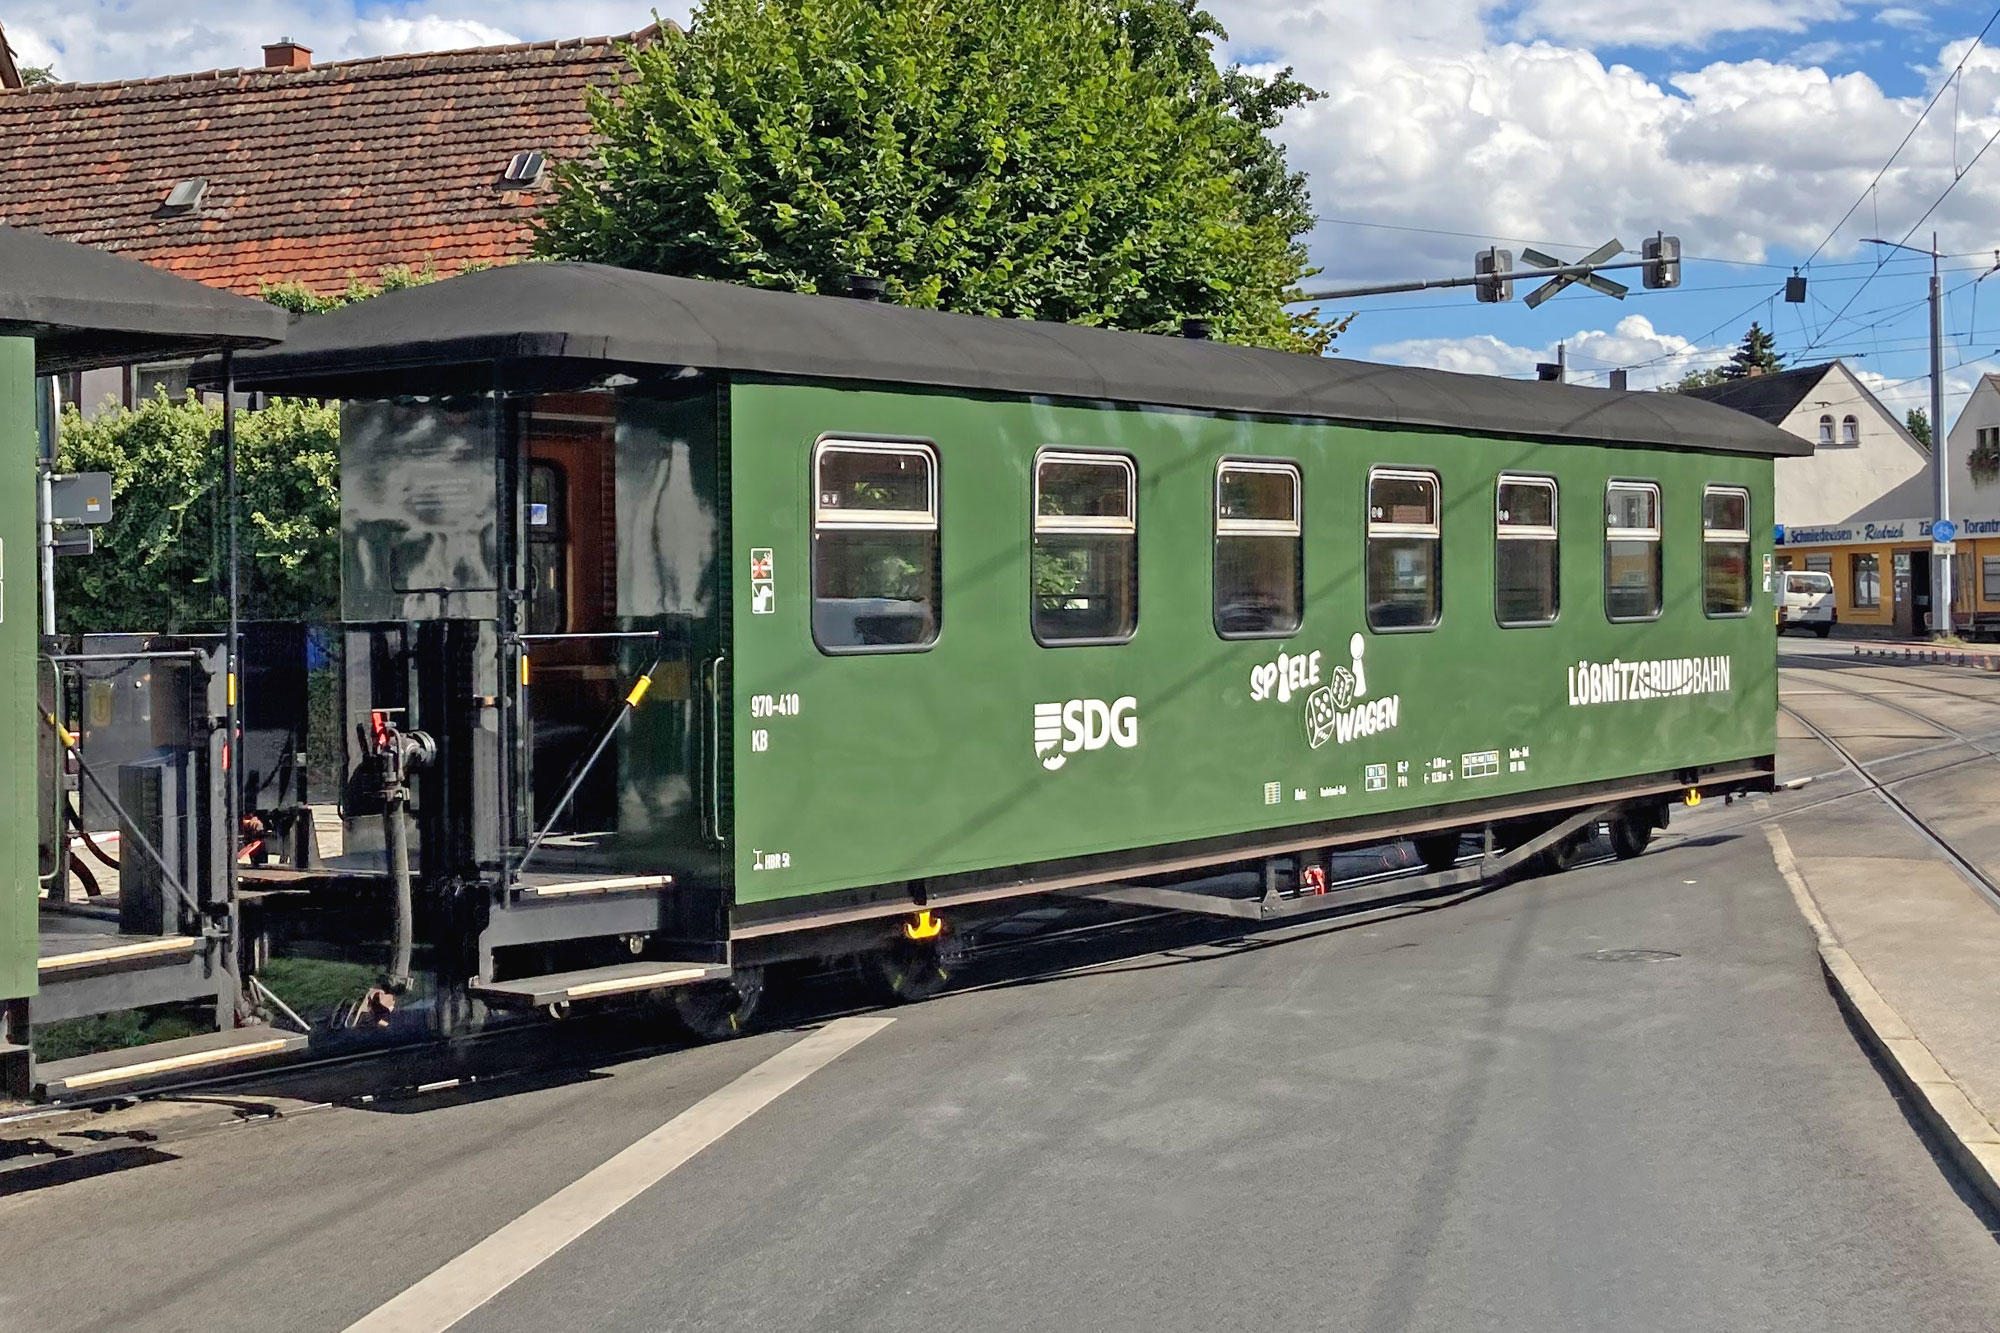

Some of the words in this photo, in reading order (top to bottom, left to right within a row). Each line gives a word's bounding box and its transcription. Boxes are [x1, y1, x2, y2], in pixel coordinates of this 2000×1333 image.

[751, 693, 799, 718] 970-410
[1336, 695, 1399, 744] WAGEN
[752, 729, 768, 752] KB
[1062, 696, 1138, 753] SDG
